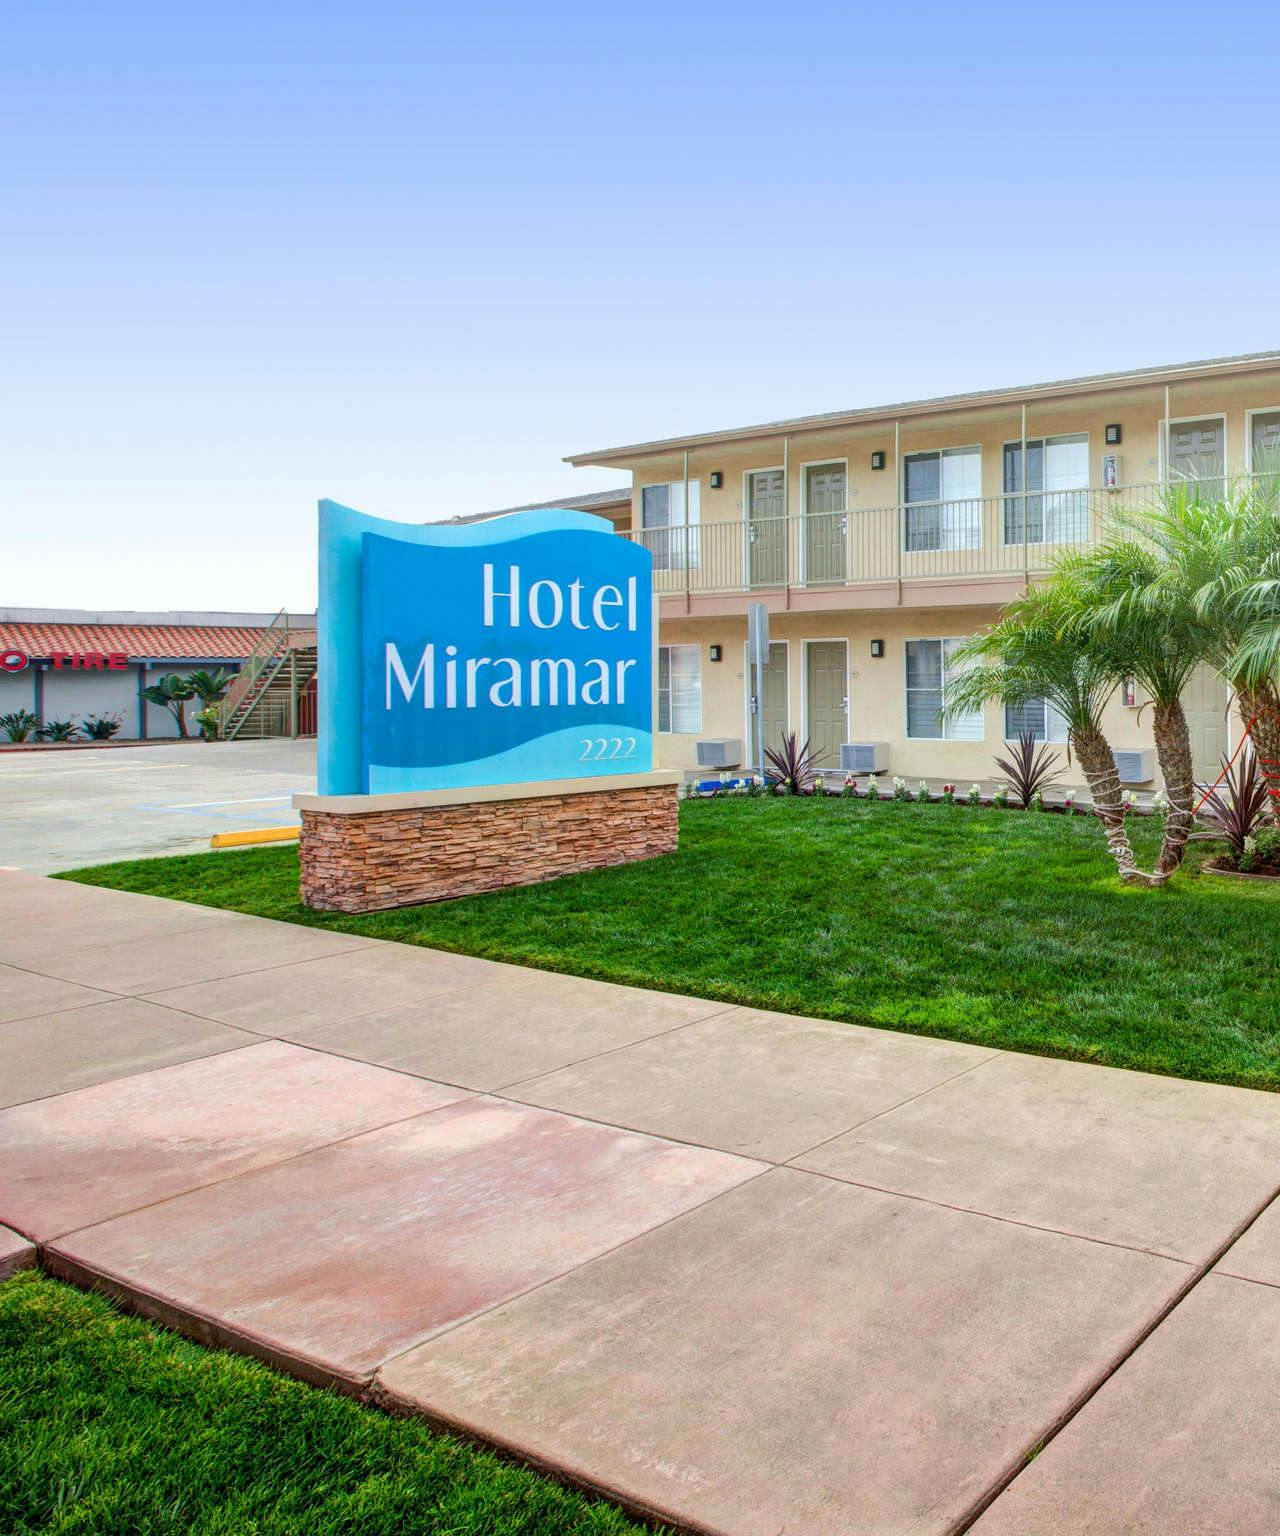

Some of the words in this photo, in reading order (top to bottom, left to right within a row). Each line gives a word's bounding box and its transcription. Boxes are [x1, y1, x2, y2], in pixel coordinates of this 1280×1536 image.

[483, 562, 638, 632] Hotel
[49, 651, 129, 671] TIRE
[384, 642, 637, 710] Miramar
[578, 736, 638, 761] 2222
